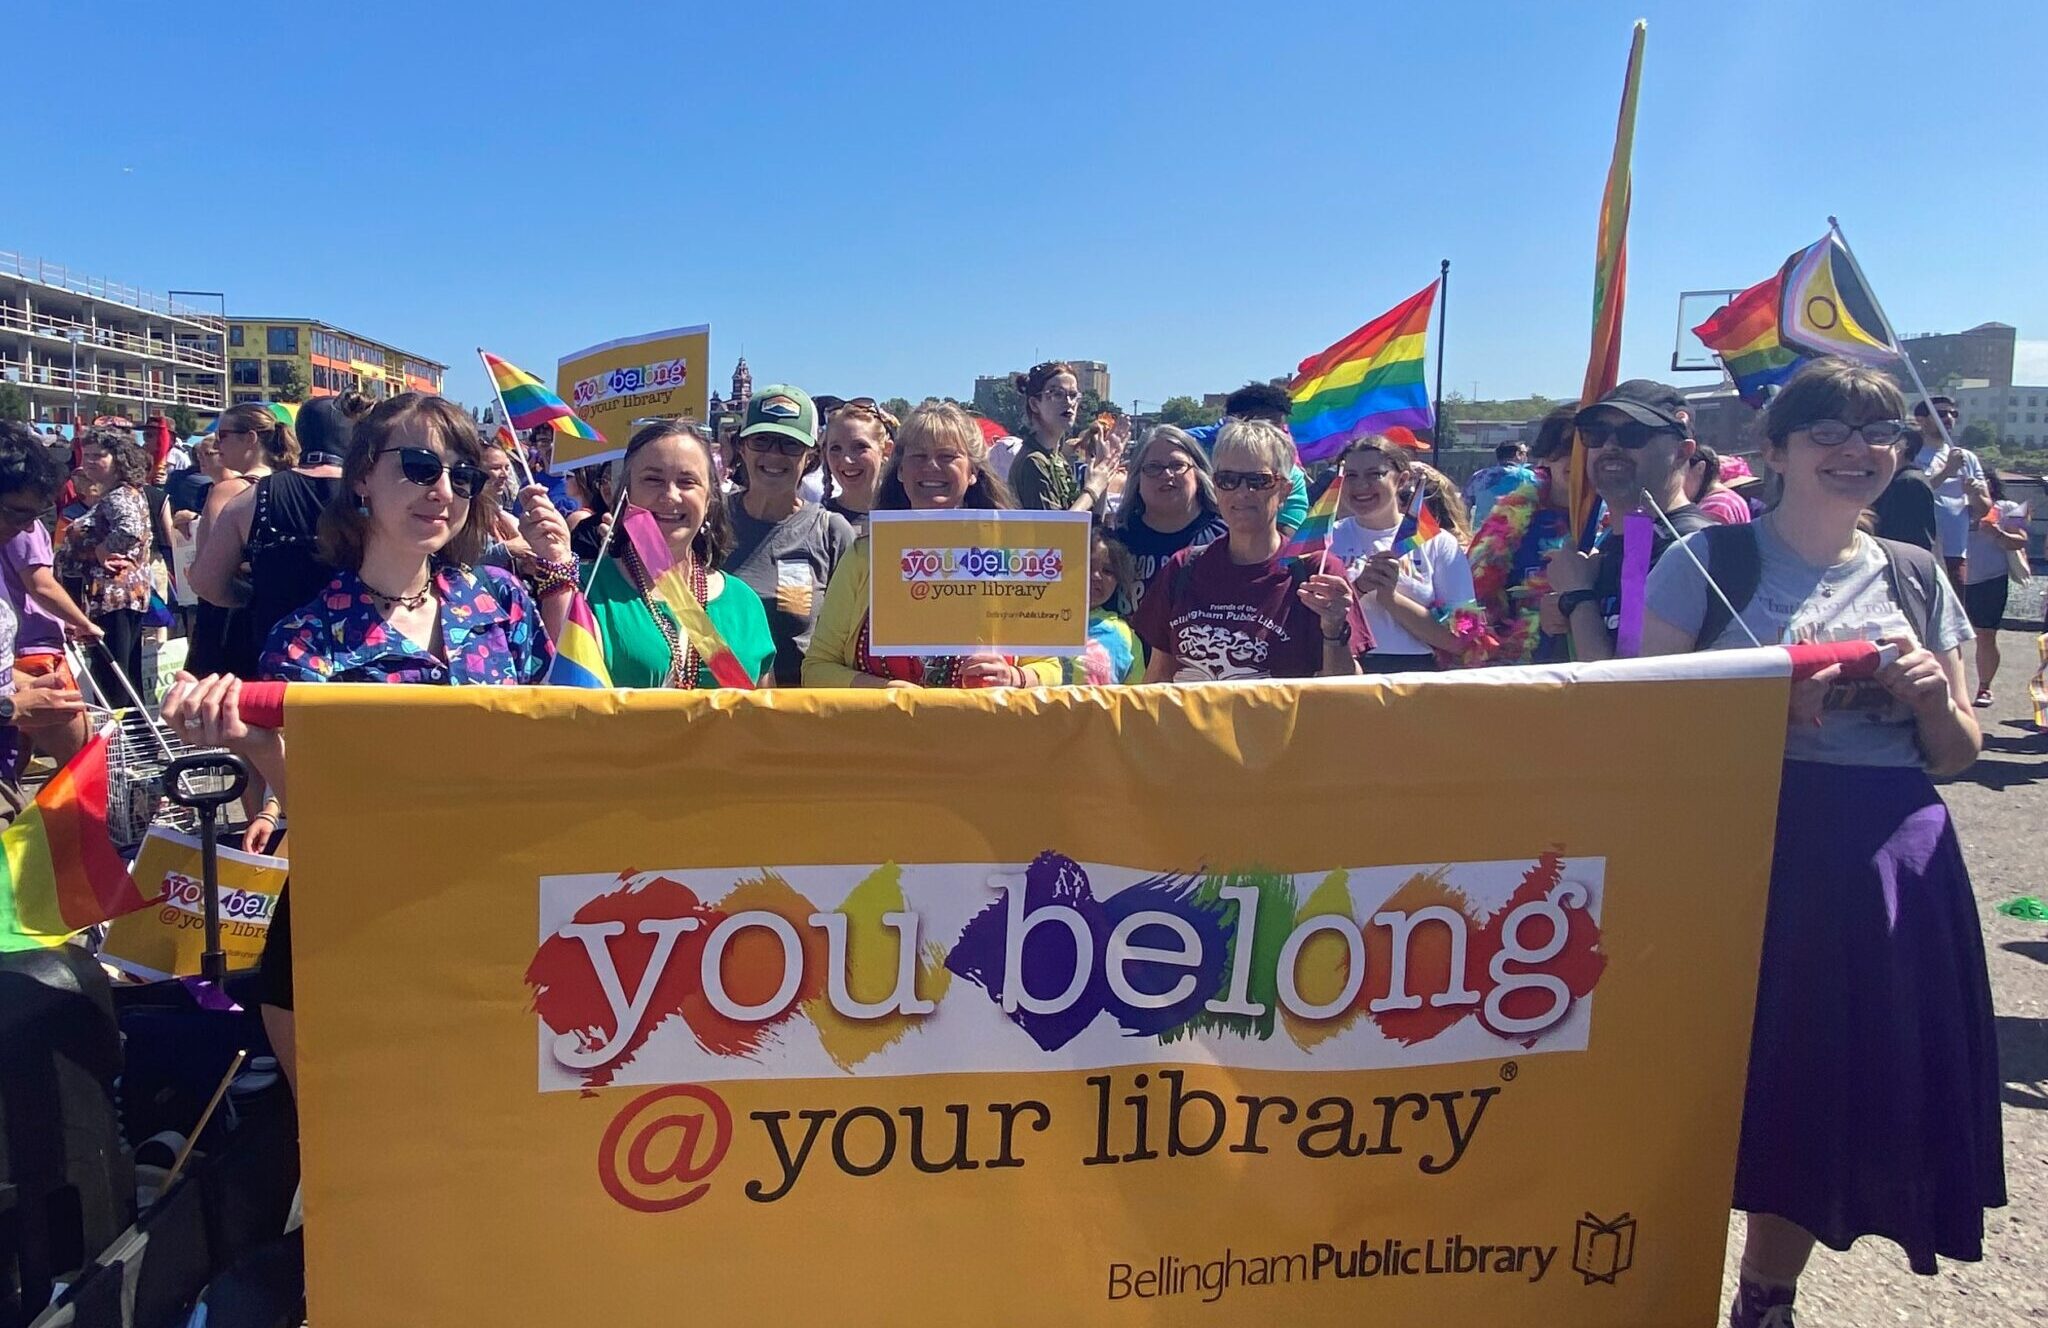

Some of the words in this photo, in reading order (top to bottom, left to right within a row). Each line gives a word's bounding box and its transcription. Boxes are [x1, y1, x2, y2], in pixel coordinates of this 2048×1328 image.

[575, 376, 605, 406] you
[613, 364, 685, 391] belong
[905, 553, 959, 578] you
[966, 549, 1061, 579] belong
[1209, 603, 1236, 611] Friends
[1237, 603, 1244, 611] of
[1246, 604, 1257, 612] the
[1226, 611, 1258, 621] Public
[1257, 614, 1291, 642] Library
[553, 910, 935, 1069] you
[987, 871, 1591, 1035] belong
